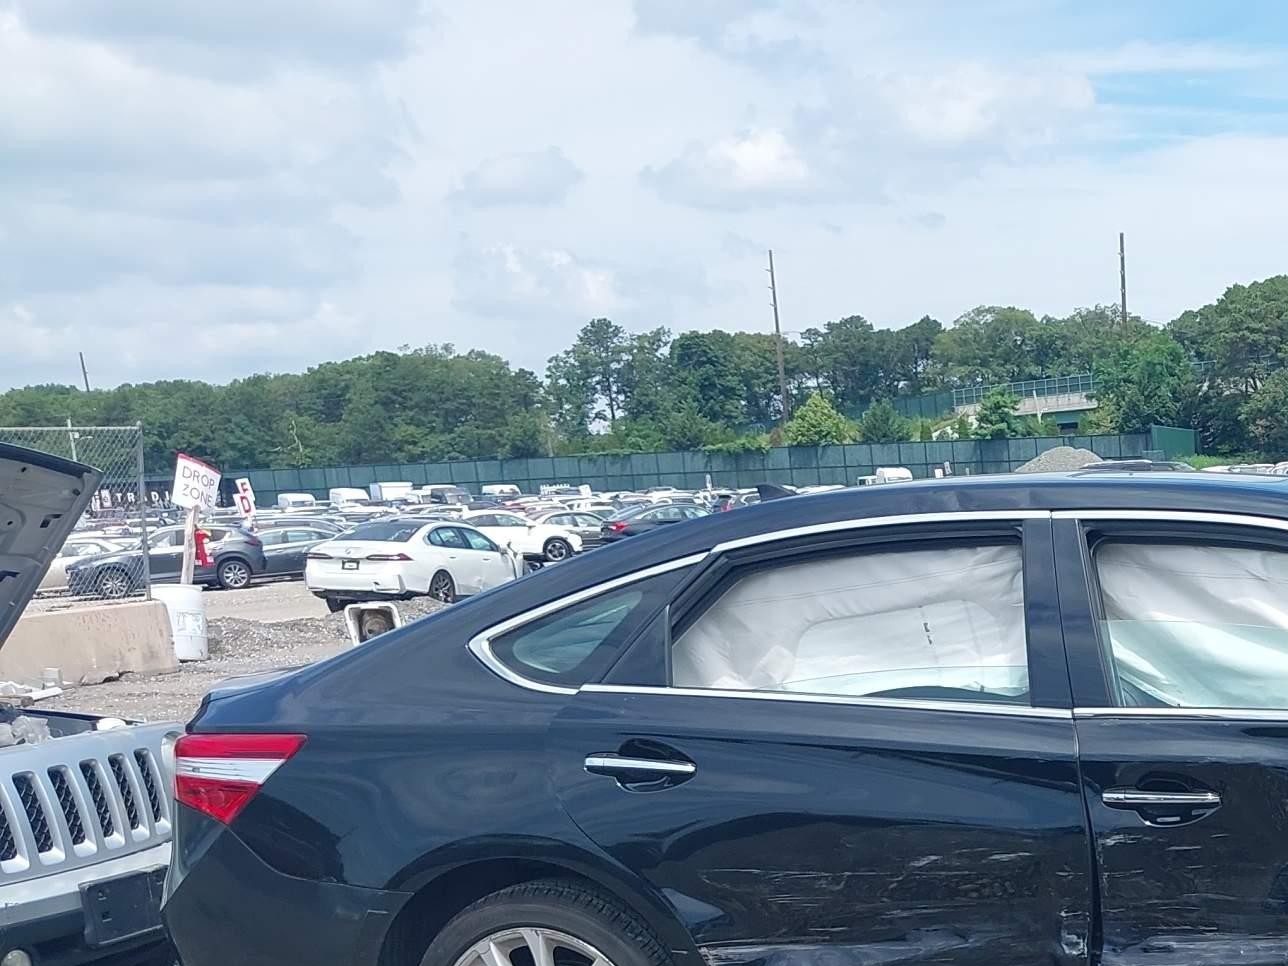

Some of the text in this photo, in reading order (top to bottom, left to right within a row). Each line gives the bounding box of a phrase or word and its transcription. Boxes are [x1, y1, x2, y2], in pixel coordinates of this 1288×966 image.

[182, 466, 215, 489] DROP
[182, 484, 213, 508] ZONE
[239, 496, 251, 513] D
